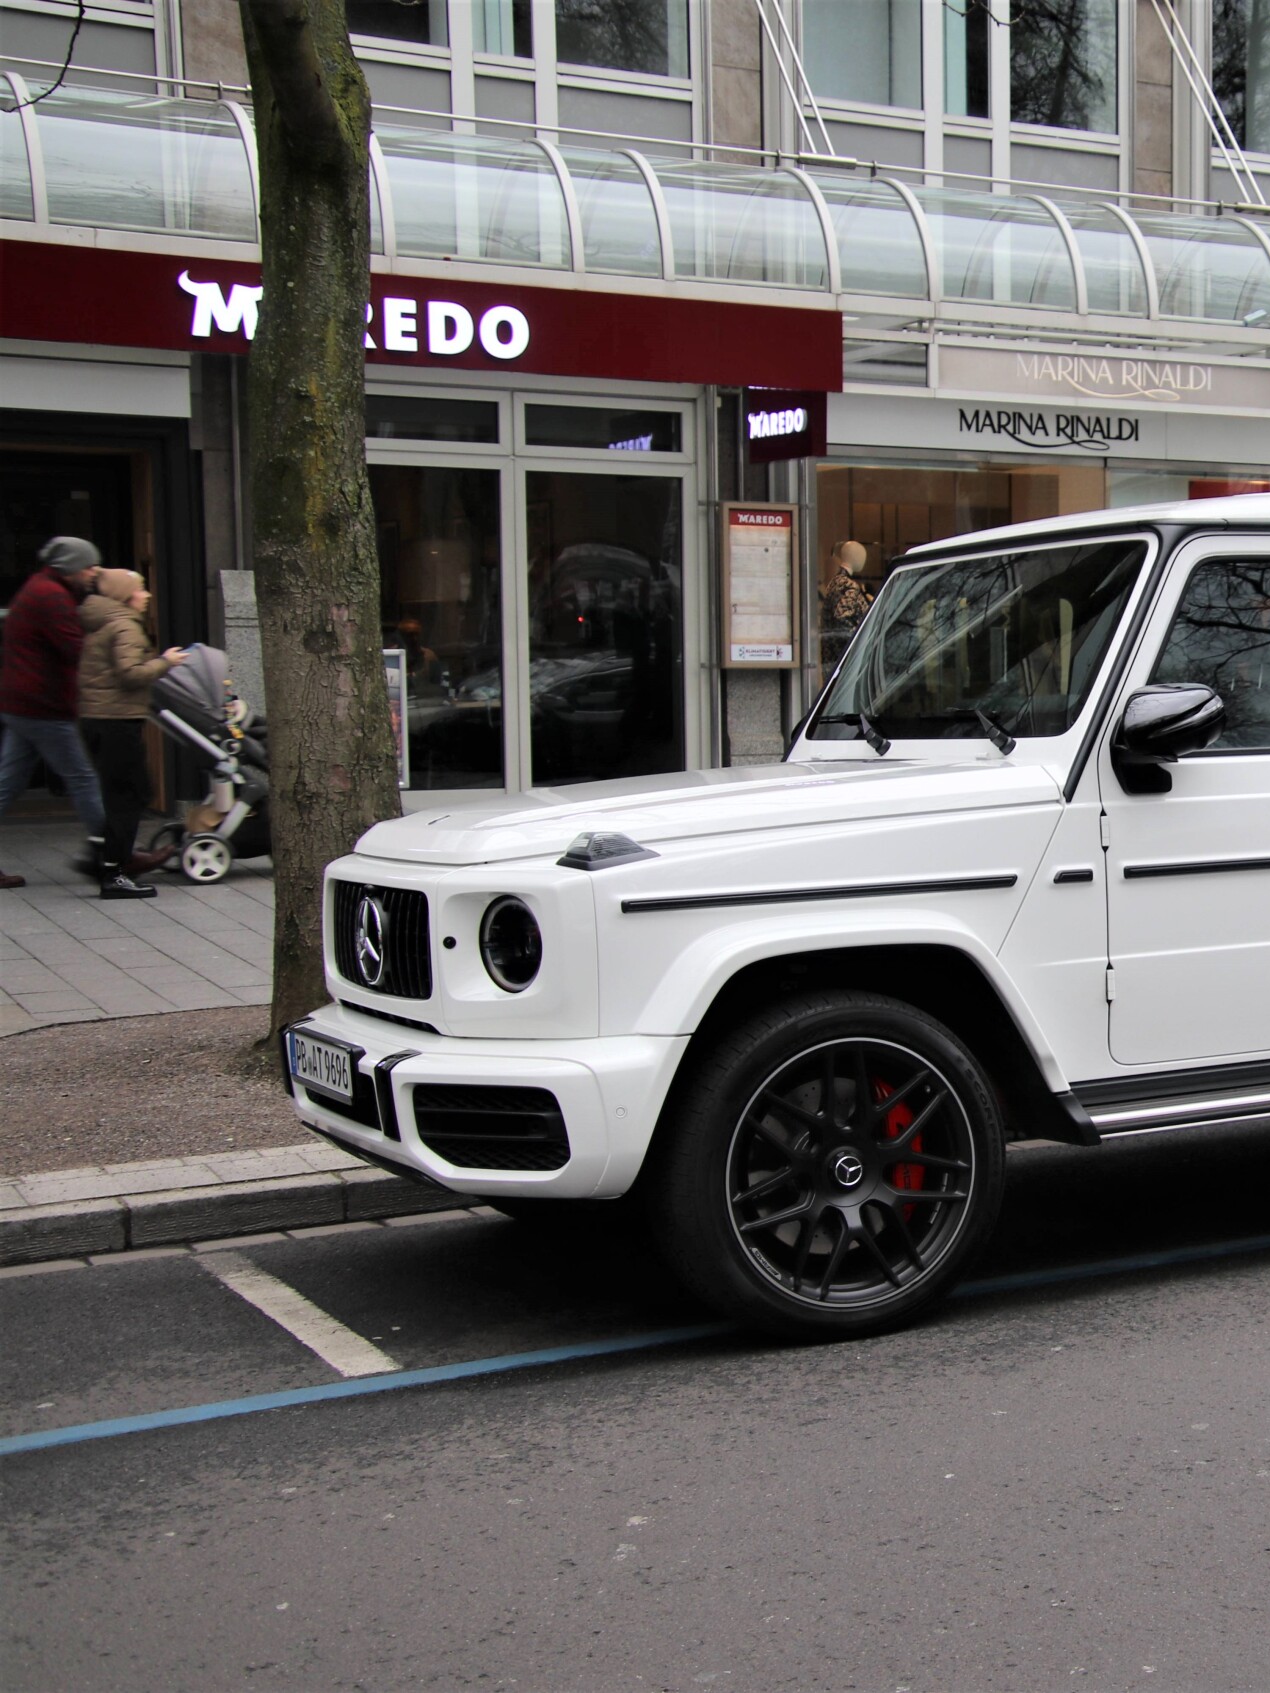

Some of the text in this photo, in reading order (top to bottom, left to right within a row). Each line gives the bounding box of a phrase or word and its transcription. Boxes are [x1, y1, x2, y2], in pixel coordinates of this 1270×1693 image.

[178, 270, 530, 359] MEDO
[1017, 353, 1212, 400] MARINA RINALDI
[748, 407, 806, 439] MAREDO
[958, 408, 1140, 450] MARINA RINALDI
[738, 513, 783, 524] MAREDO
[295, 1038, 349, 1090] PB AT 9696
